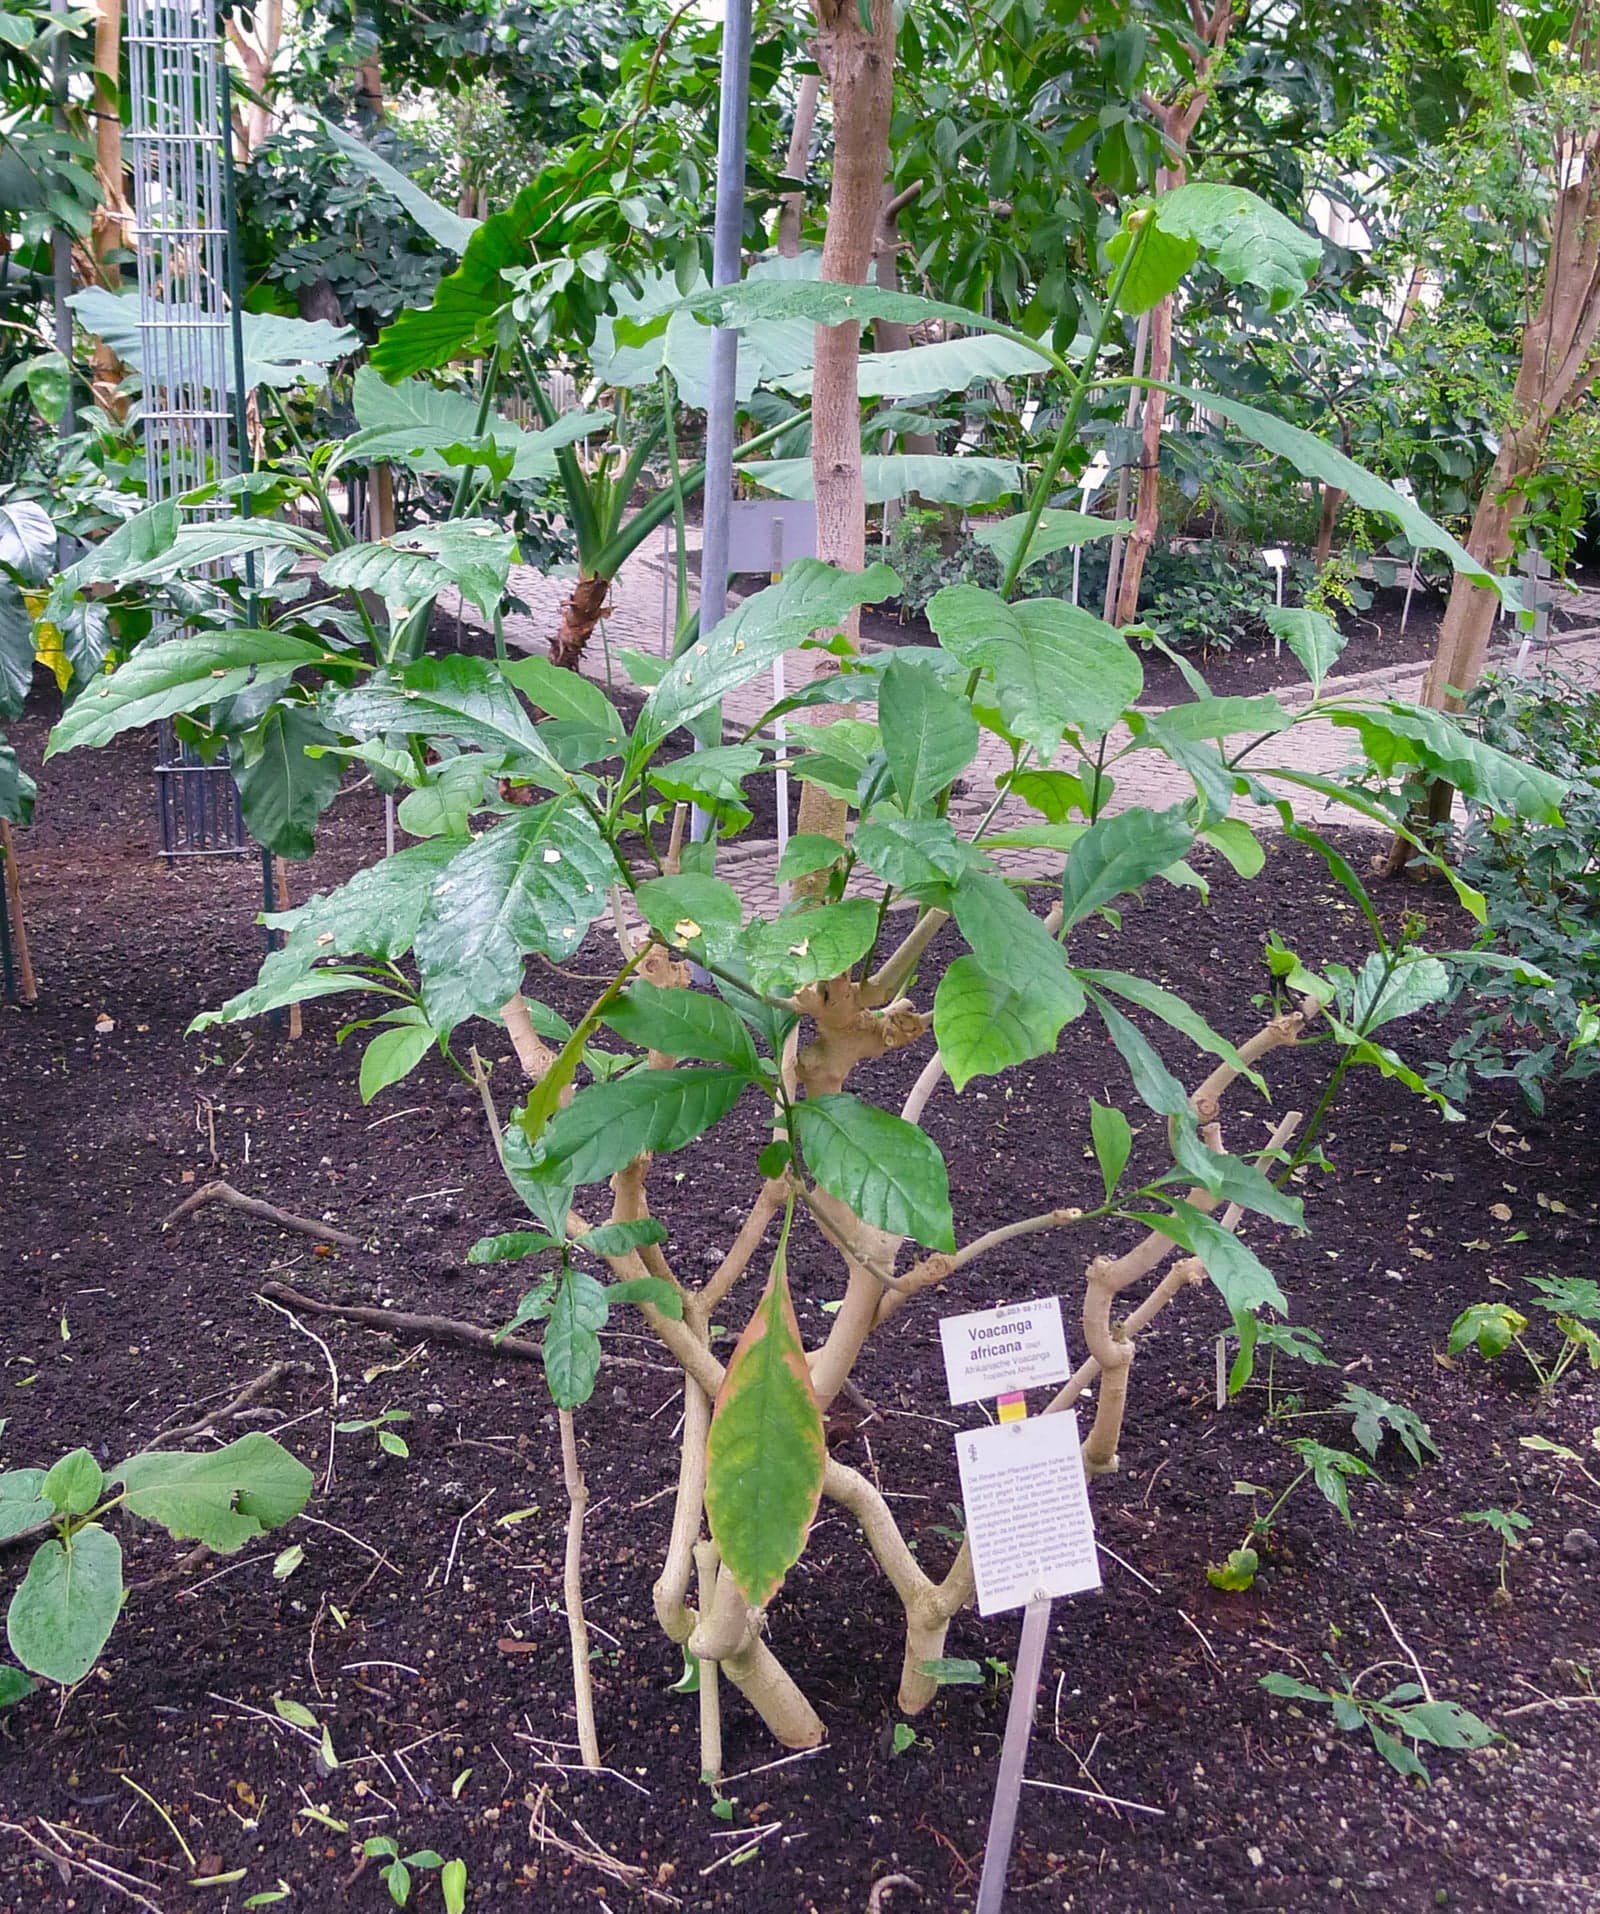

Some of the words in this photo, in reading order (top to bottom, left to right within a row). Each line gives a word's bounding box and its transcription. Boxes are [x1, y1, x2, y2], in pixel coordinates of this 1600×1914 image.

[968, 1319, 1032, 1341] Voacanga
[970, 1340, 1022, 1360] africana
[964, 1358, 1010, 1373] Afrikanische
[1012, 1351, 1050, 1365] Voacanga
